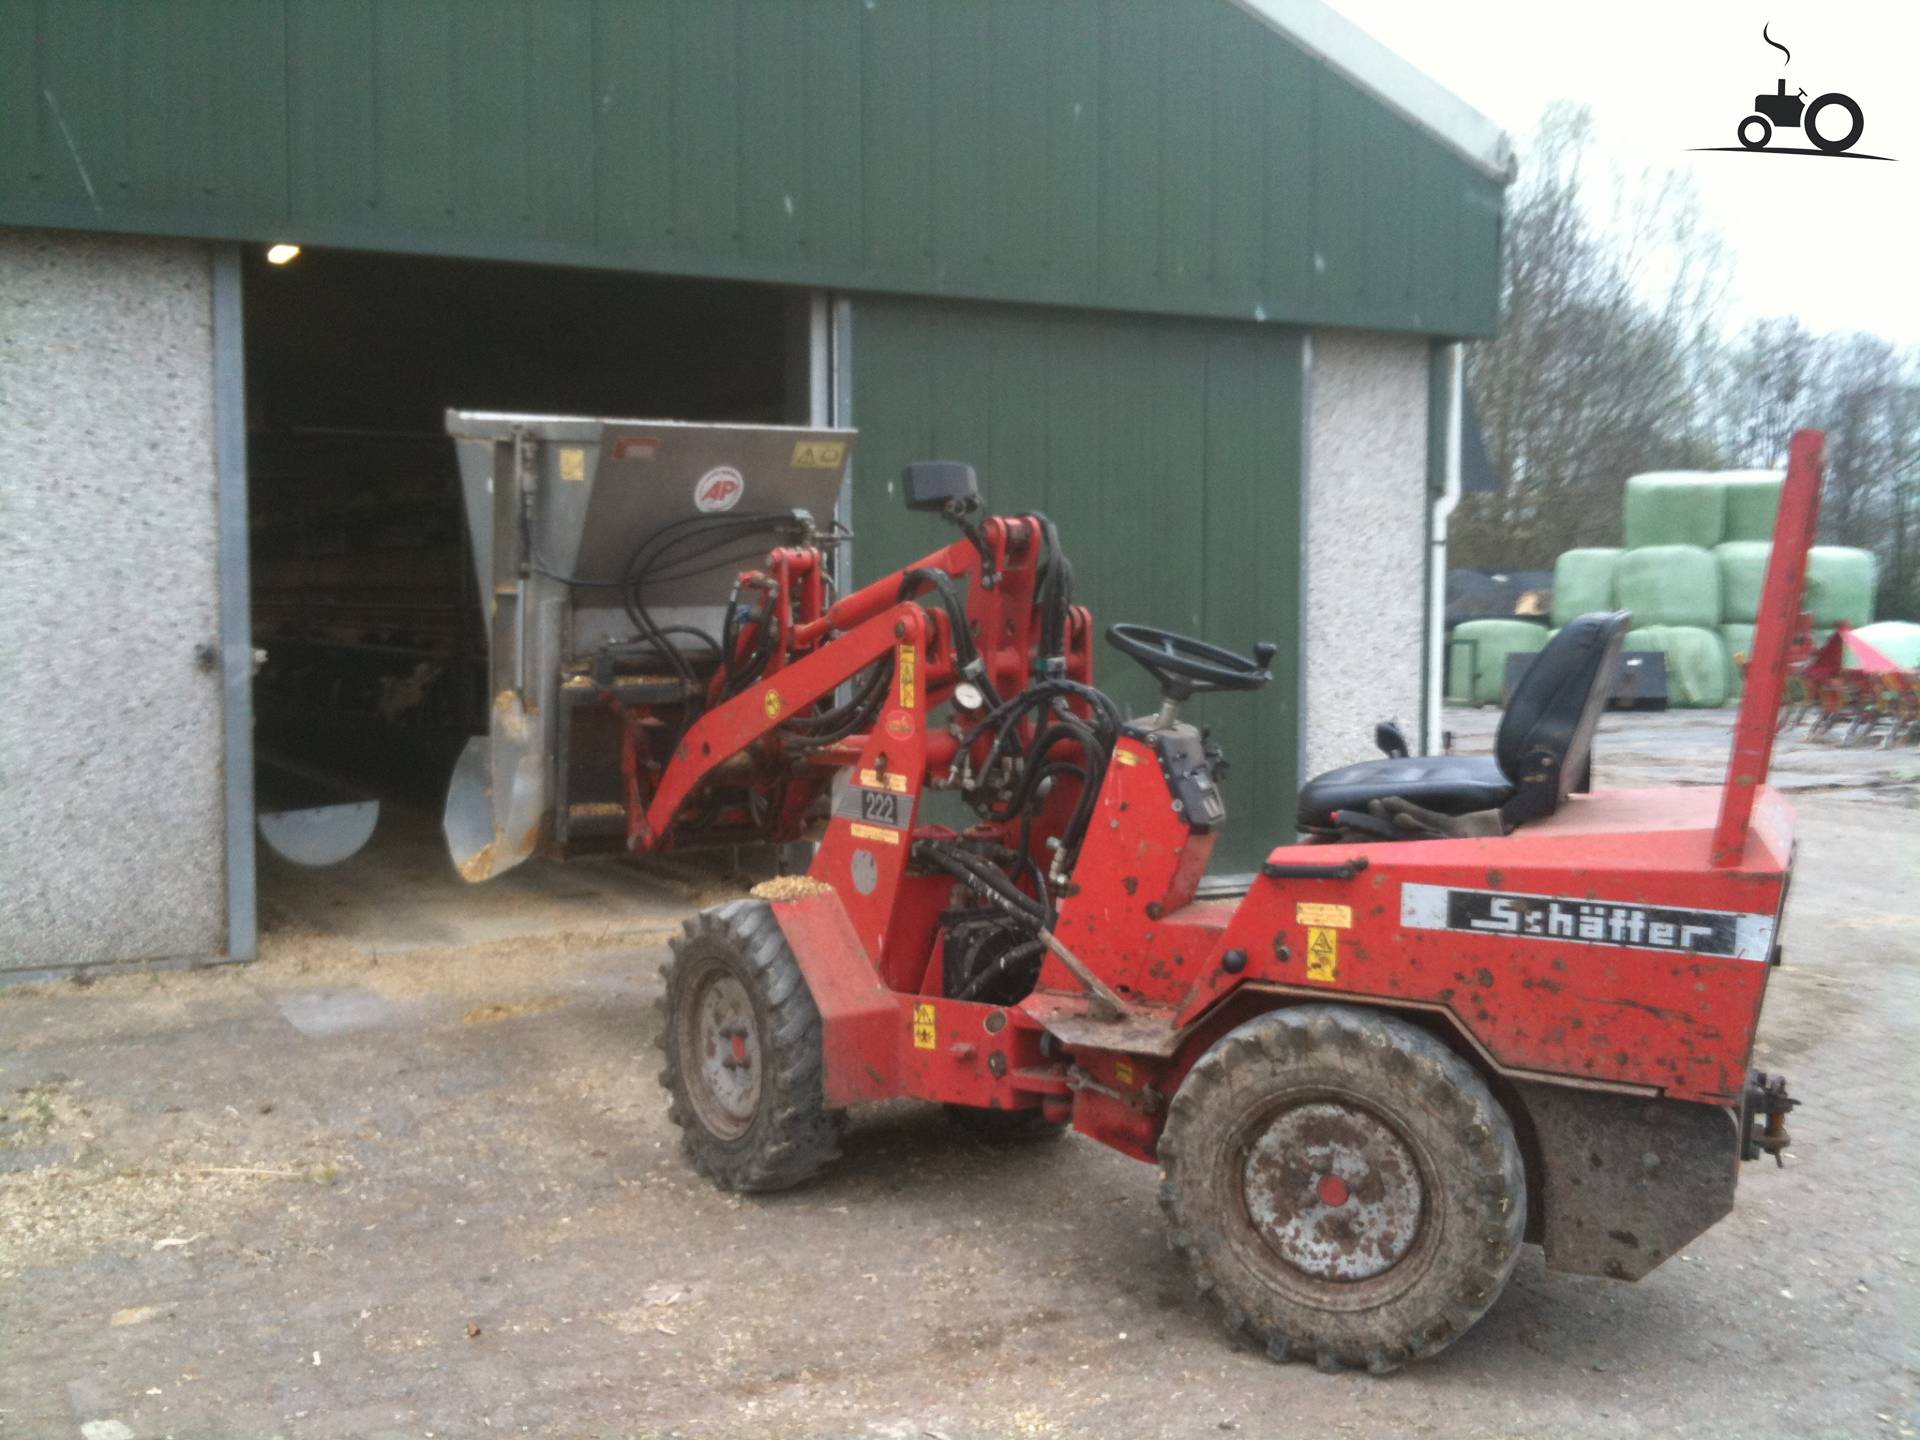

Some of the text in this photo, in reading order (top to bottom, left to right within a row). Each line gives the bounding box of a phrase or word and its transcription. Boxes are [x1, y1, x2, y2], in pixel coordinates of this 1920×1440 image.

[703, 479, 737, 501] AP
[866, 792, 895, 824] 222
[1470, 898, 1713, 948] Schäffer
